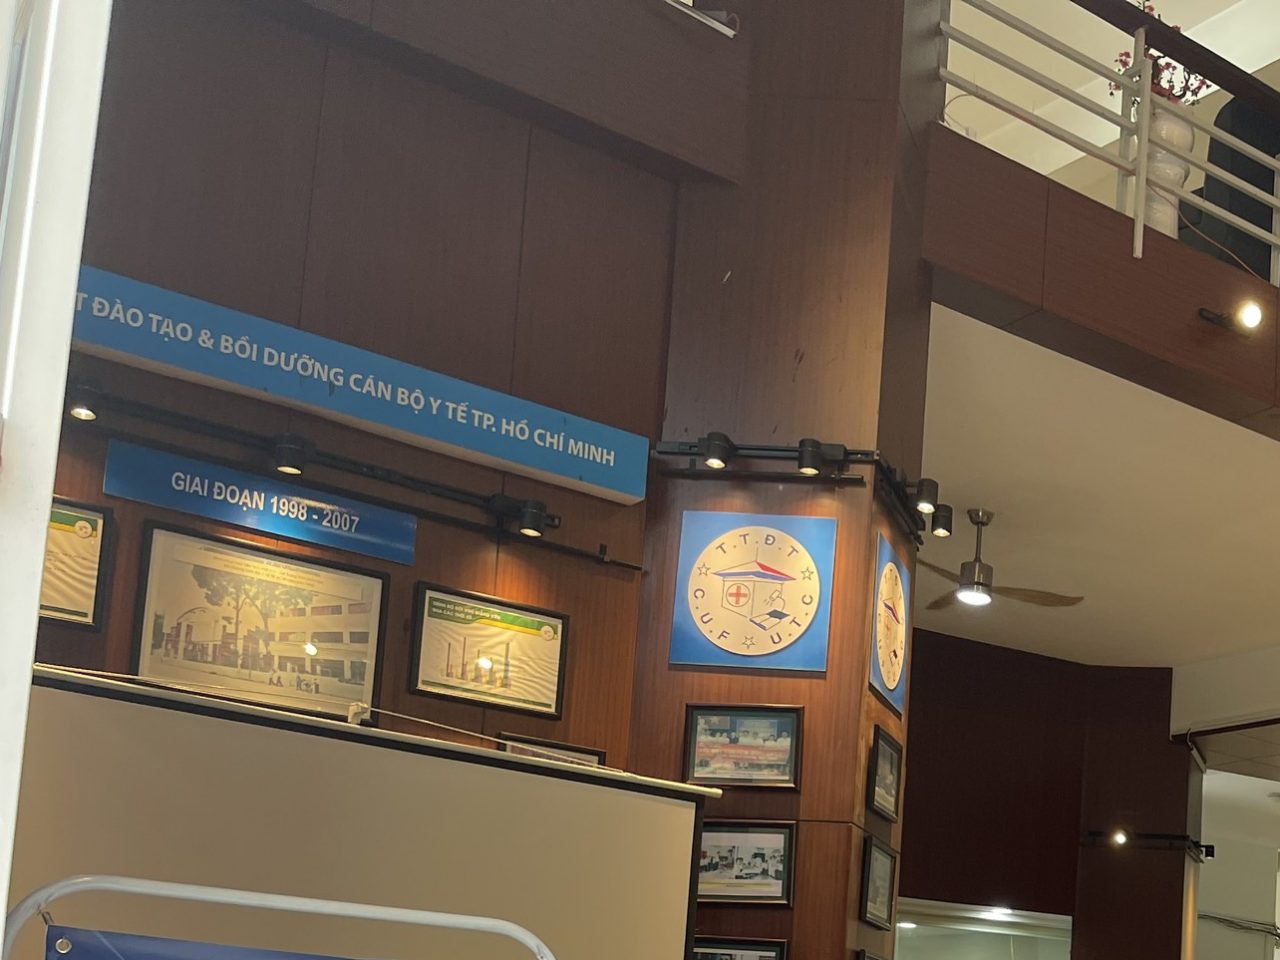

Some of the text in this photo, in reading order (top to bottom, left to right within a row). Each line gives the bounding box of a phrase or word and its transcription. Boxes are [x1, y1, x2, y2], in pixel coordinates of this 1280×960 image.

[92, 297, 144, 328] ĐÀO
[149, 313, 193, 342] TẠO
[198, 329, 214, 349] &
[219, 334, 257, 362] BỒI
[263, 348, 344, 386] DƯỠNG
[349, 373, 392, 400] CÁN
[397, 387, 425, 414] BỘ
[429, 397, 442, 415] Y
[445, 401, 469, 423] TẾ
[471, 409, 496, 433] TP.
[501, 418, 529, 440] HỒ
[533, 428, 564, 451] CHÍ
[568, 438, 615, 467] MINH
[171, 472, 208, 496] GIAI
[213, 482, 265, 511] ĐOẠN
[270, 496, 308, 521] 1998
[321, 510, 360, 533] 2007
